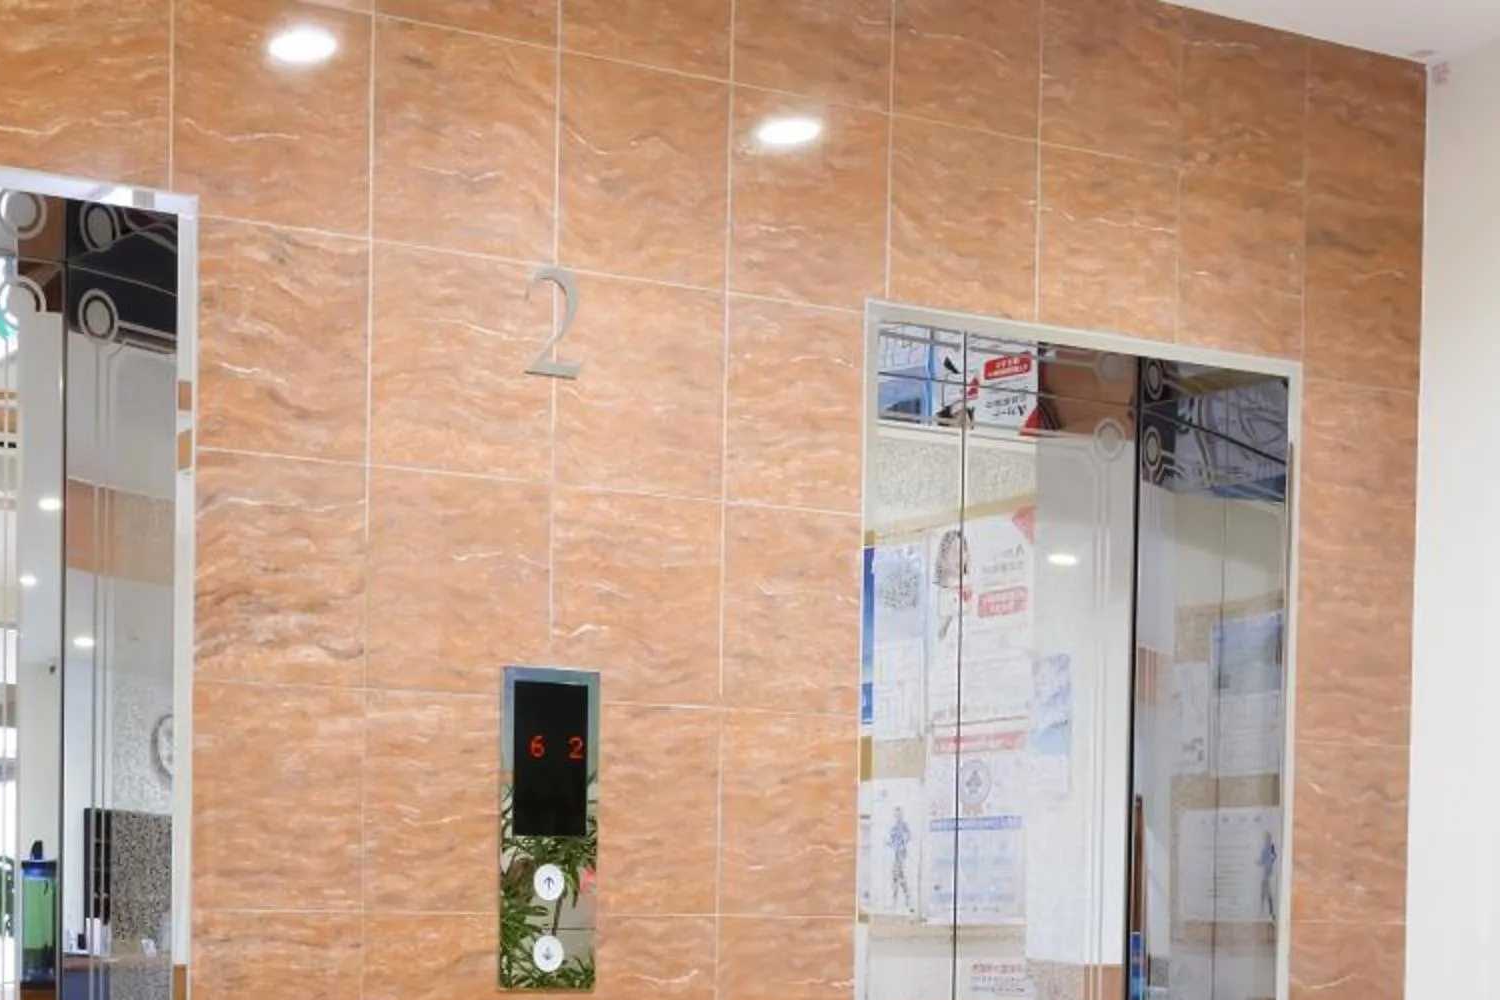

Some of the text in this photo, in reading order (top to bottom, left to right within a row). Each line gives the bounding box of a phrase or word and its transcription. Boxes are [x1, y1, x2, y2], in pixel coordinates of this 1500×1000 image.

[524, 266, 581, 380] 2
[529, 735, 585, 760] 6 2
